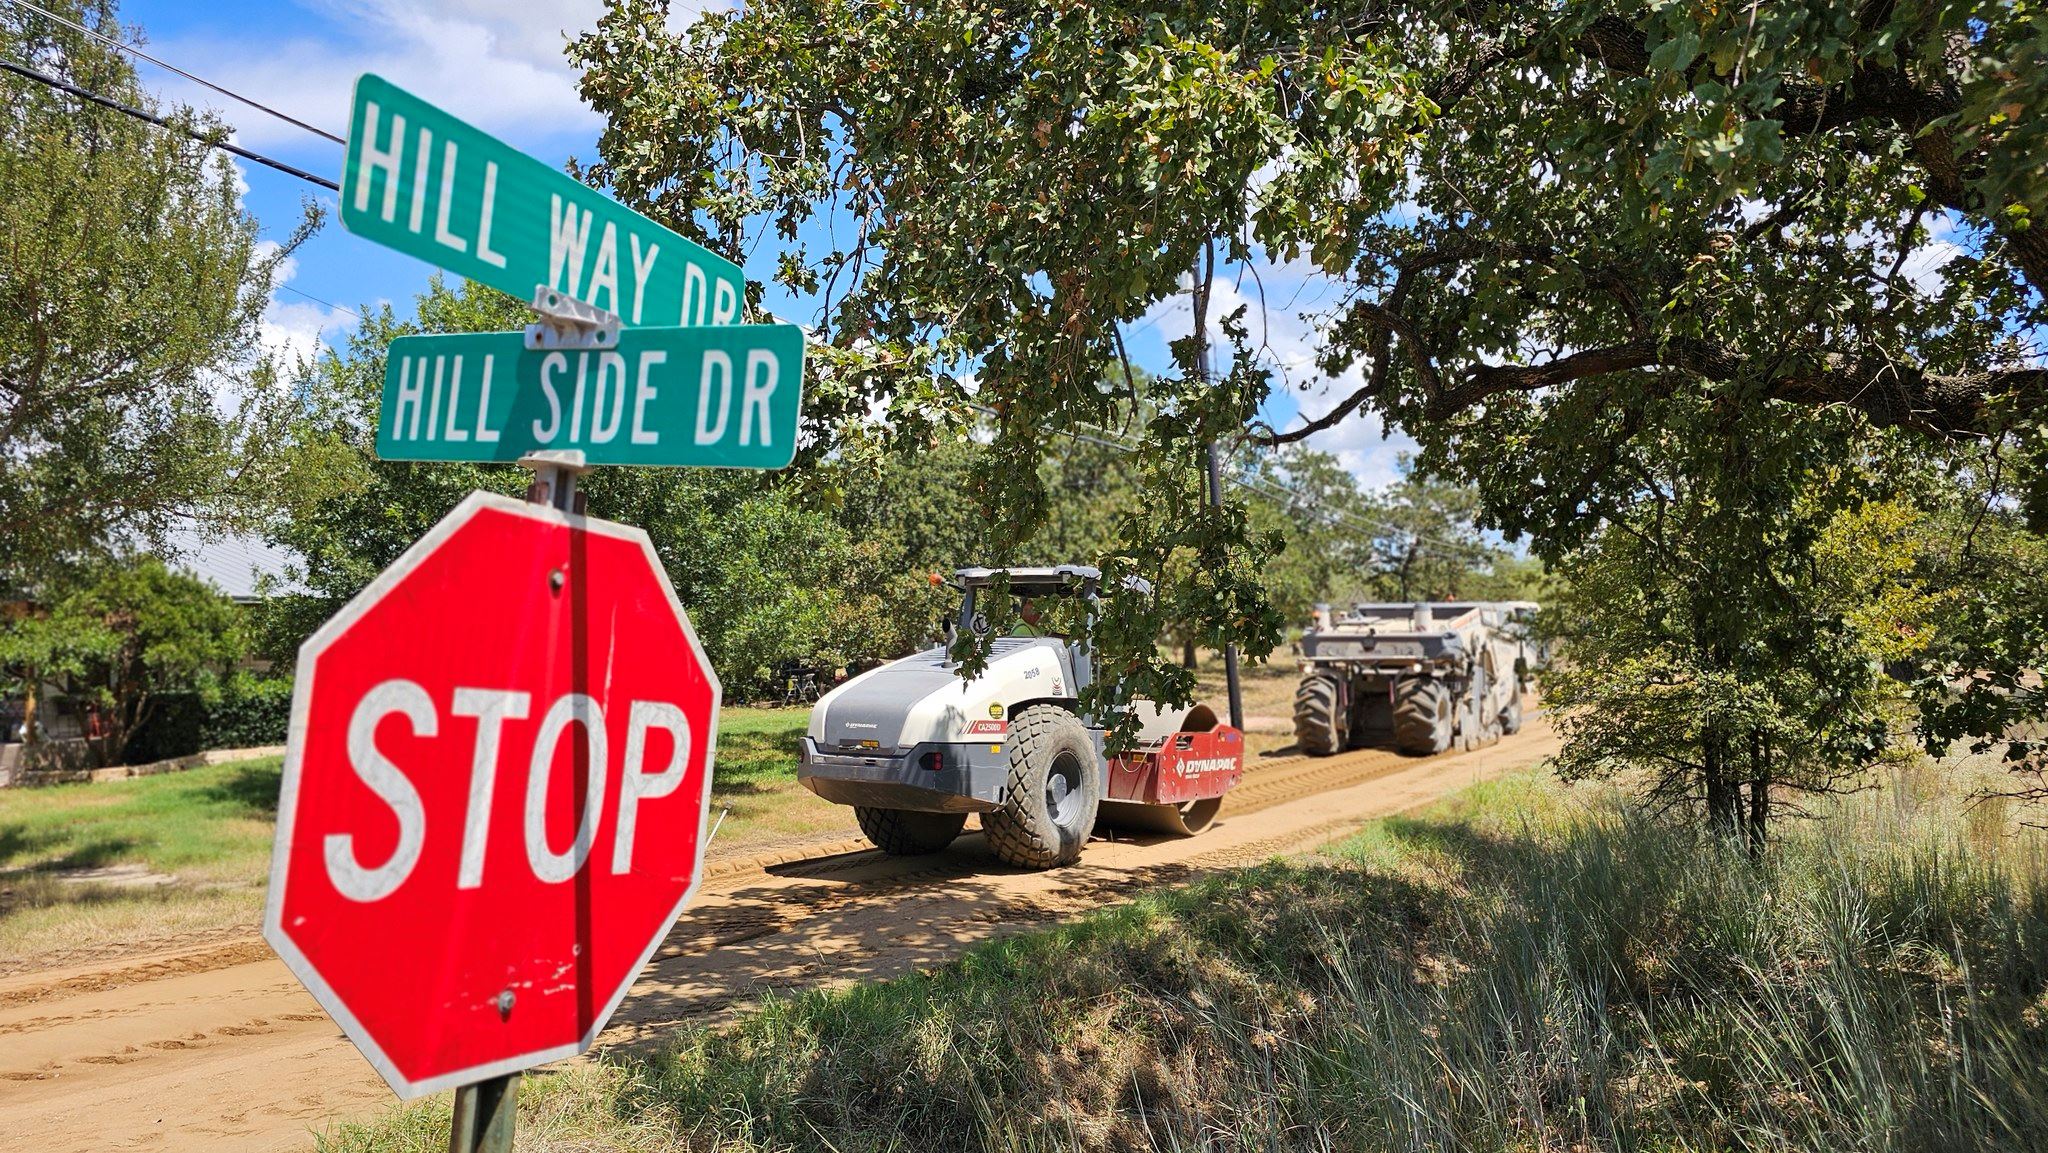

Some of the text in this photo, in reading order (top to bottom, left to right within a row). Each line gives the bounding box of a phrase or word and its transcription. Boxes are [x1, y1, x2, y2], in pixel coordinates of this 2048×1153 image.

[354, 100, 738, 328] HILL WAY DR
[392, 348, 780, 447] HILL SIDE DR
[323, 679, 692, 903] STOP
[1185, 757, 1237, 773] DYNAPAC
